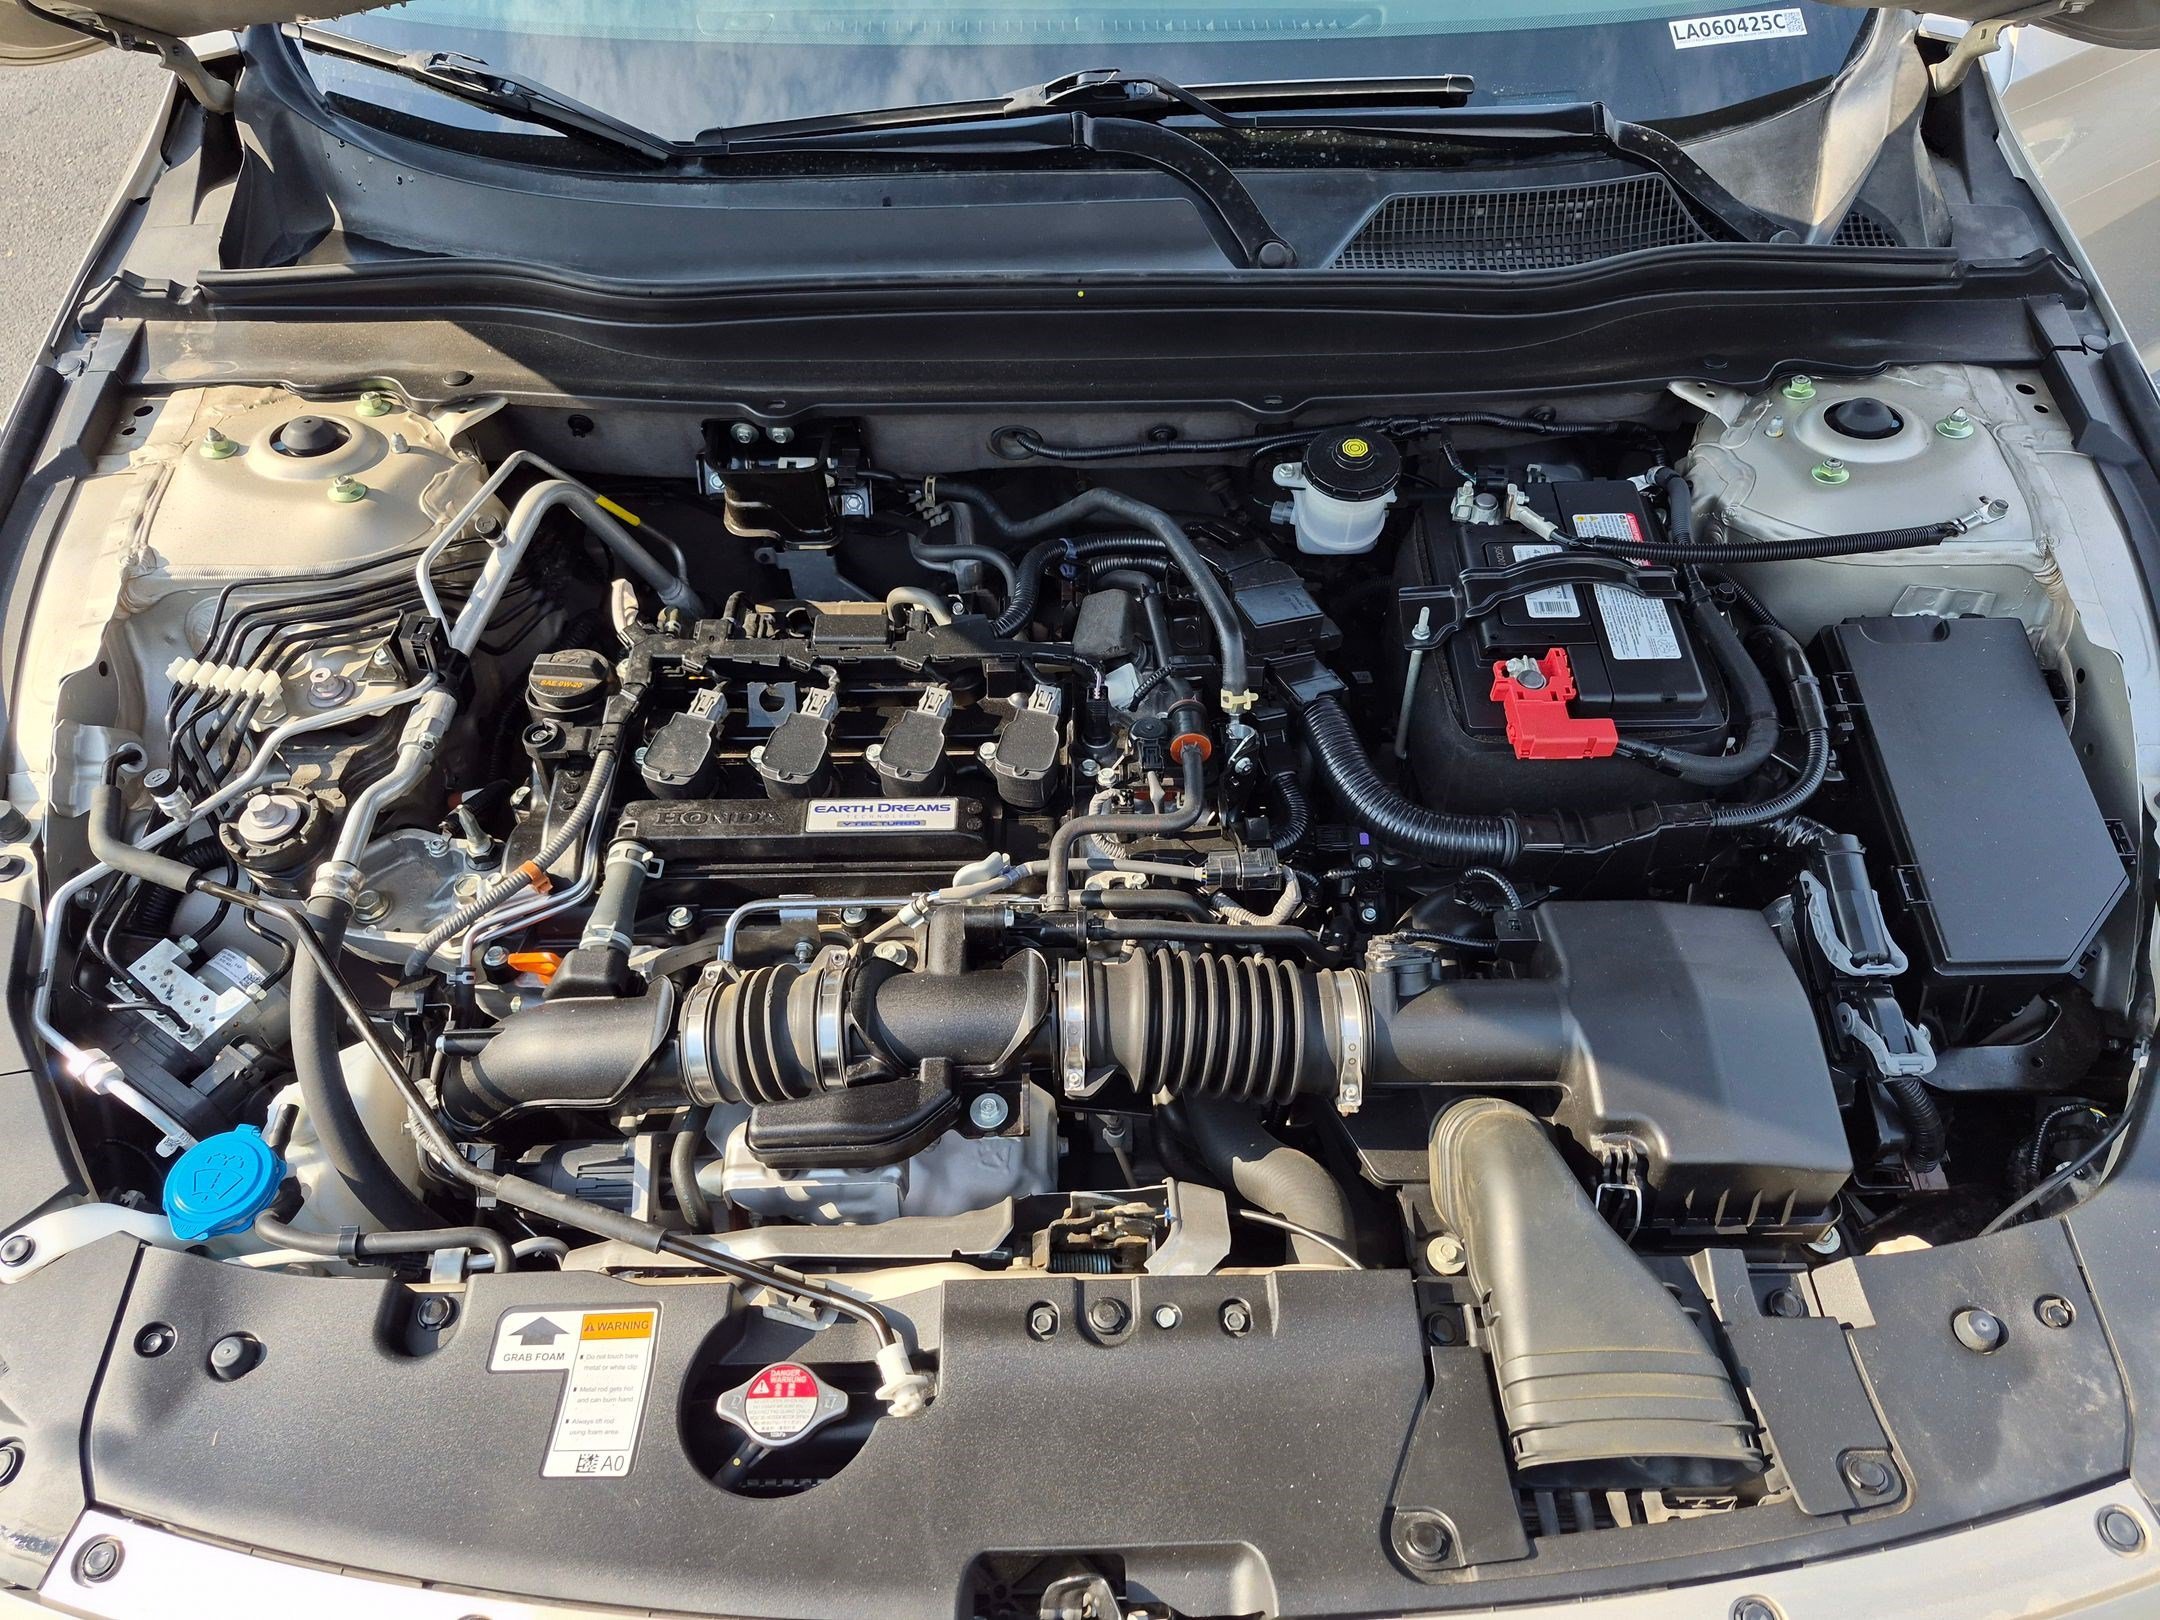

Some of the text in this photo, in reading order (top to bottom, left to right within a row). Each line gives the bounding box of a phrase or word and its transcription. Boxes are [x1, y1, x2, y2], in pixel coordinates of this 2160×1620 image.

[1673, 14, 1786, 40] LA060425C
[558, 680, 583, 688] 0W-20
[814, 803, 951, 813] EARTH DREAMS
[656, 809, 784, 826] HONDA
[597, 1319, 649, 1332] WARNING
[503, 1352, 565, 1362] GRAB FOAM
[770, 1369, 801, 1377] DANGER
[600, 1455, 624, 1472] A0
